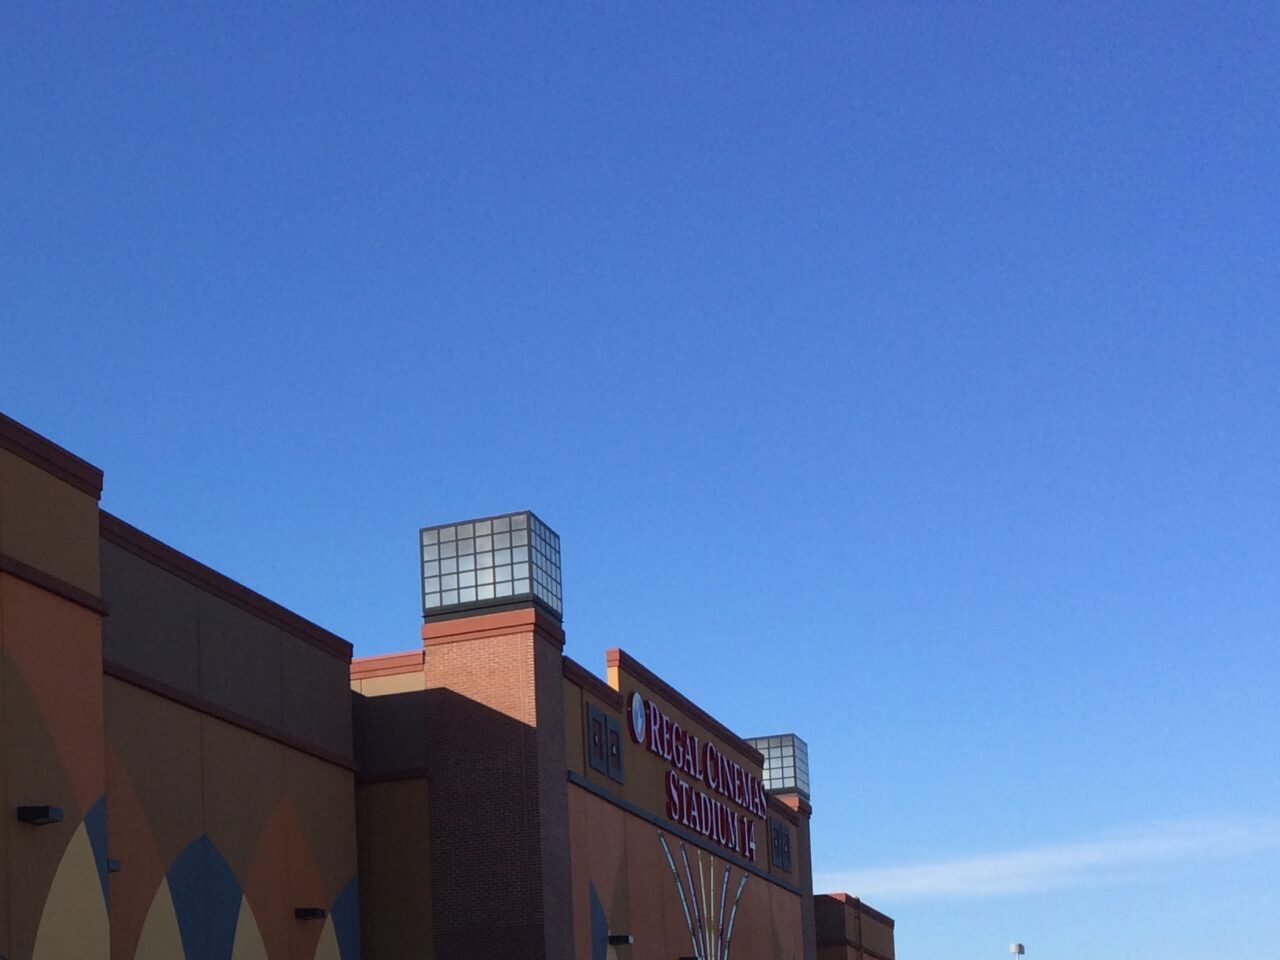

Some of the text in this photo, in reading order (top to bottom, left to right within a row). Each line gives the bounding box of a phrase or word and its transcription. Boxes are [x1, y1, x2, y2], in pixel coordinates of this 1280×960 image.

[647, 700, 767, 820] REGAL CINEMAS
[666, 770, 757, 862] STADIUM 14
